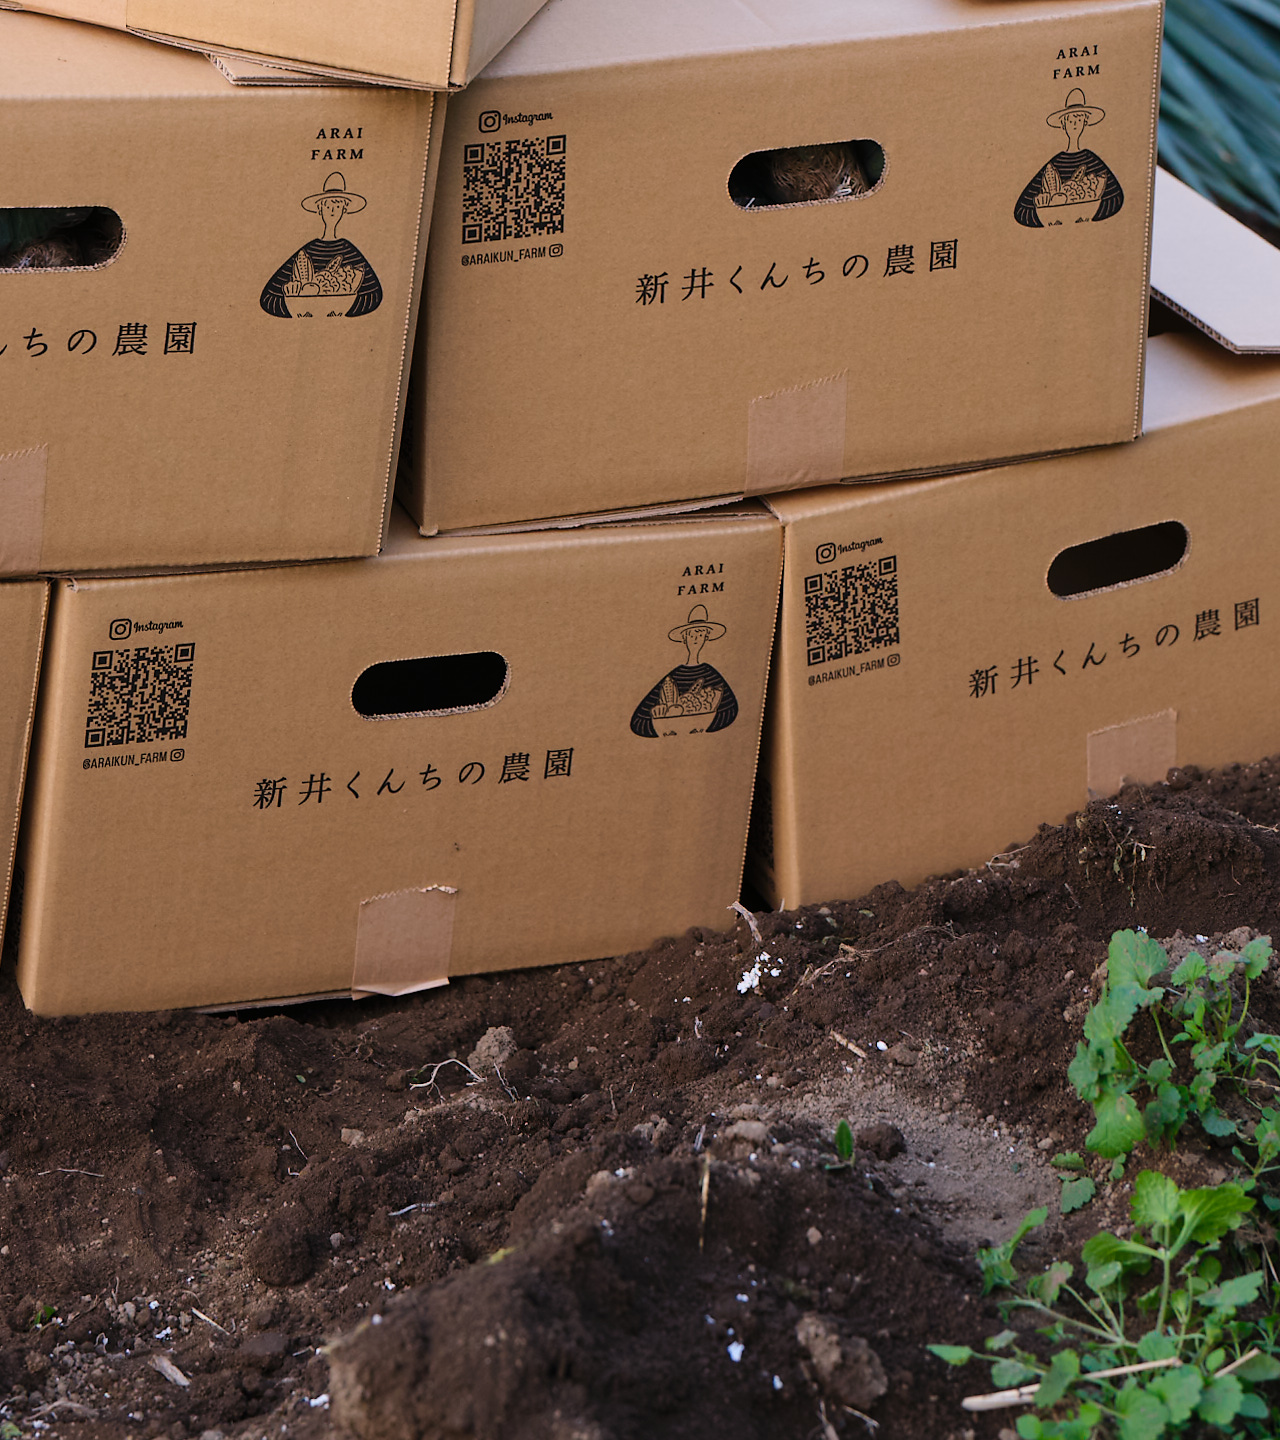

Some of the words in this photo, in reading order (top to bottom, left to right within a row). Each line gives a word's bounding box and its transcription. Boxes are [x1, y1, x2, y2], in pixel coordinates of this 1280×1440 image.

[1055, 44, 1098, 60] ARAI
[1053, 63, 1100, 80] FARM
[502, 112, 554, 127] Instagram
[315, 127, 363, 140] ARAI
[310, 148, 364, 161] FARM
[635, 238, 959, 306] 新井くんちの農園
[837, 536, 884, 556] Instagram
[681, 563, 724, 577] ARAI
[677, 581, 725, 596] FARM
[133, 620, 184, 635] Instagram
[968, 598, 1260, 699] 新井くんちの農園
[252, 747, 575, 810] 新井くんちの農園
